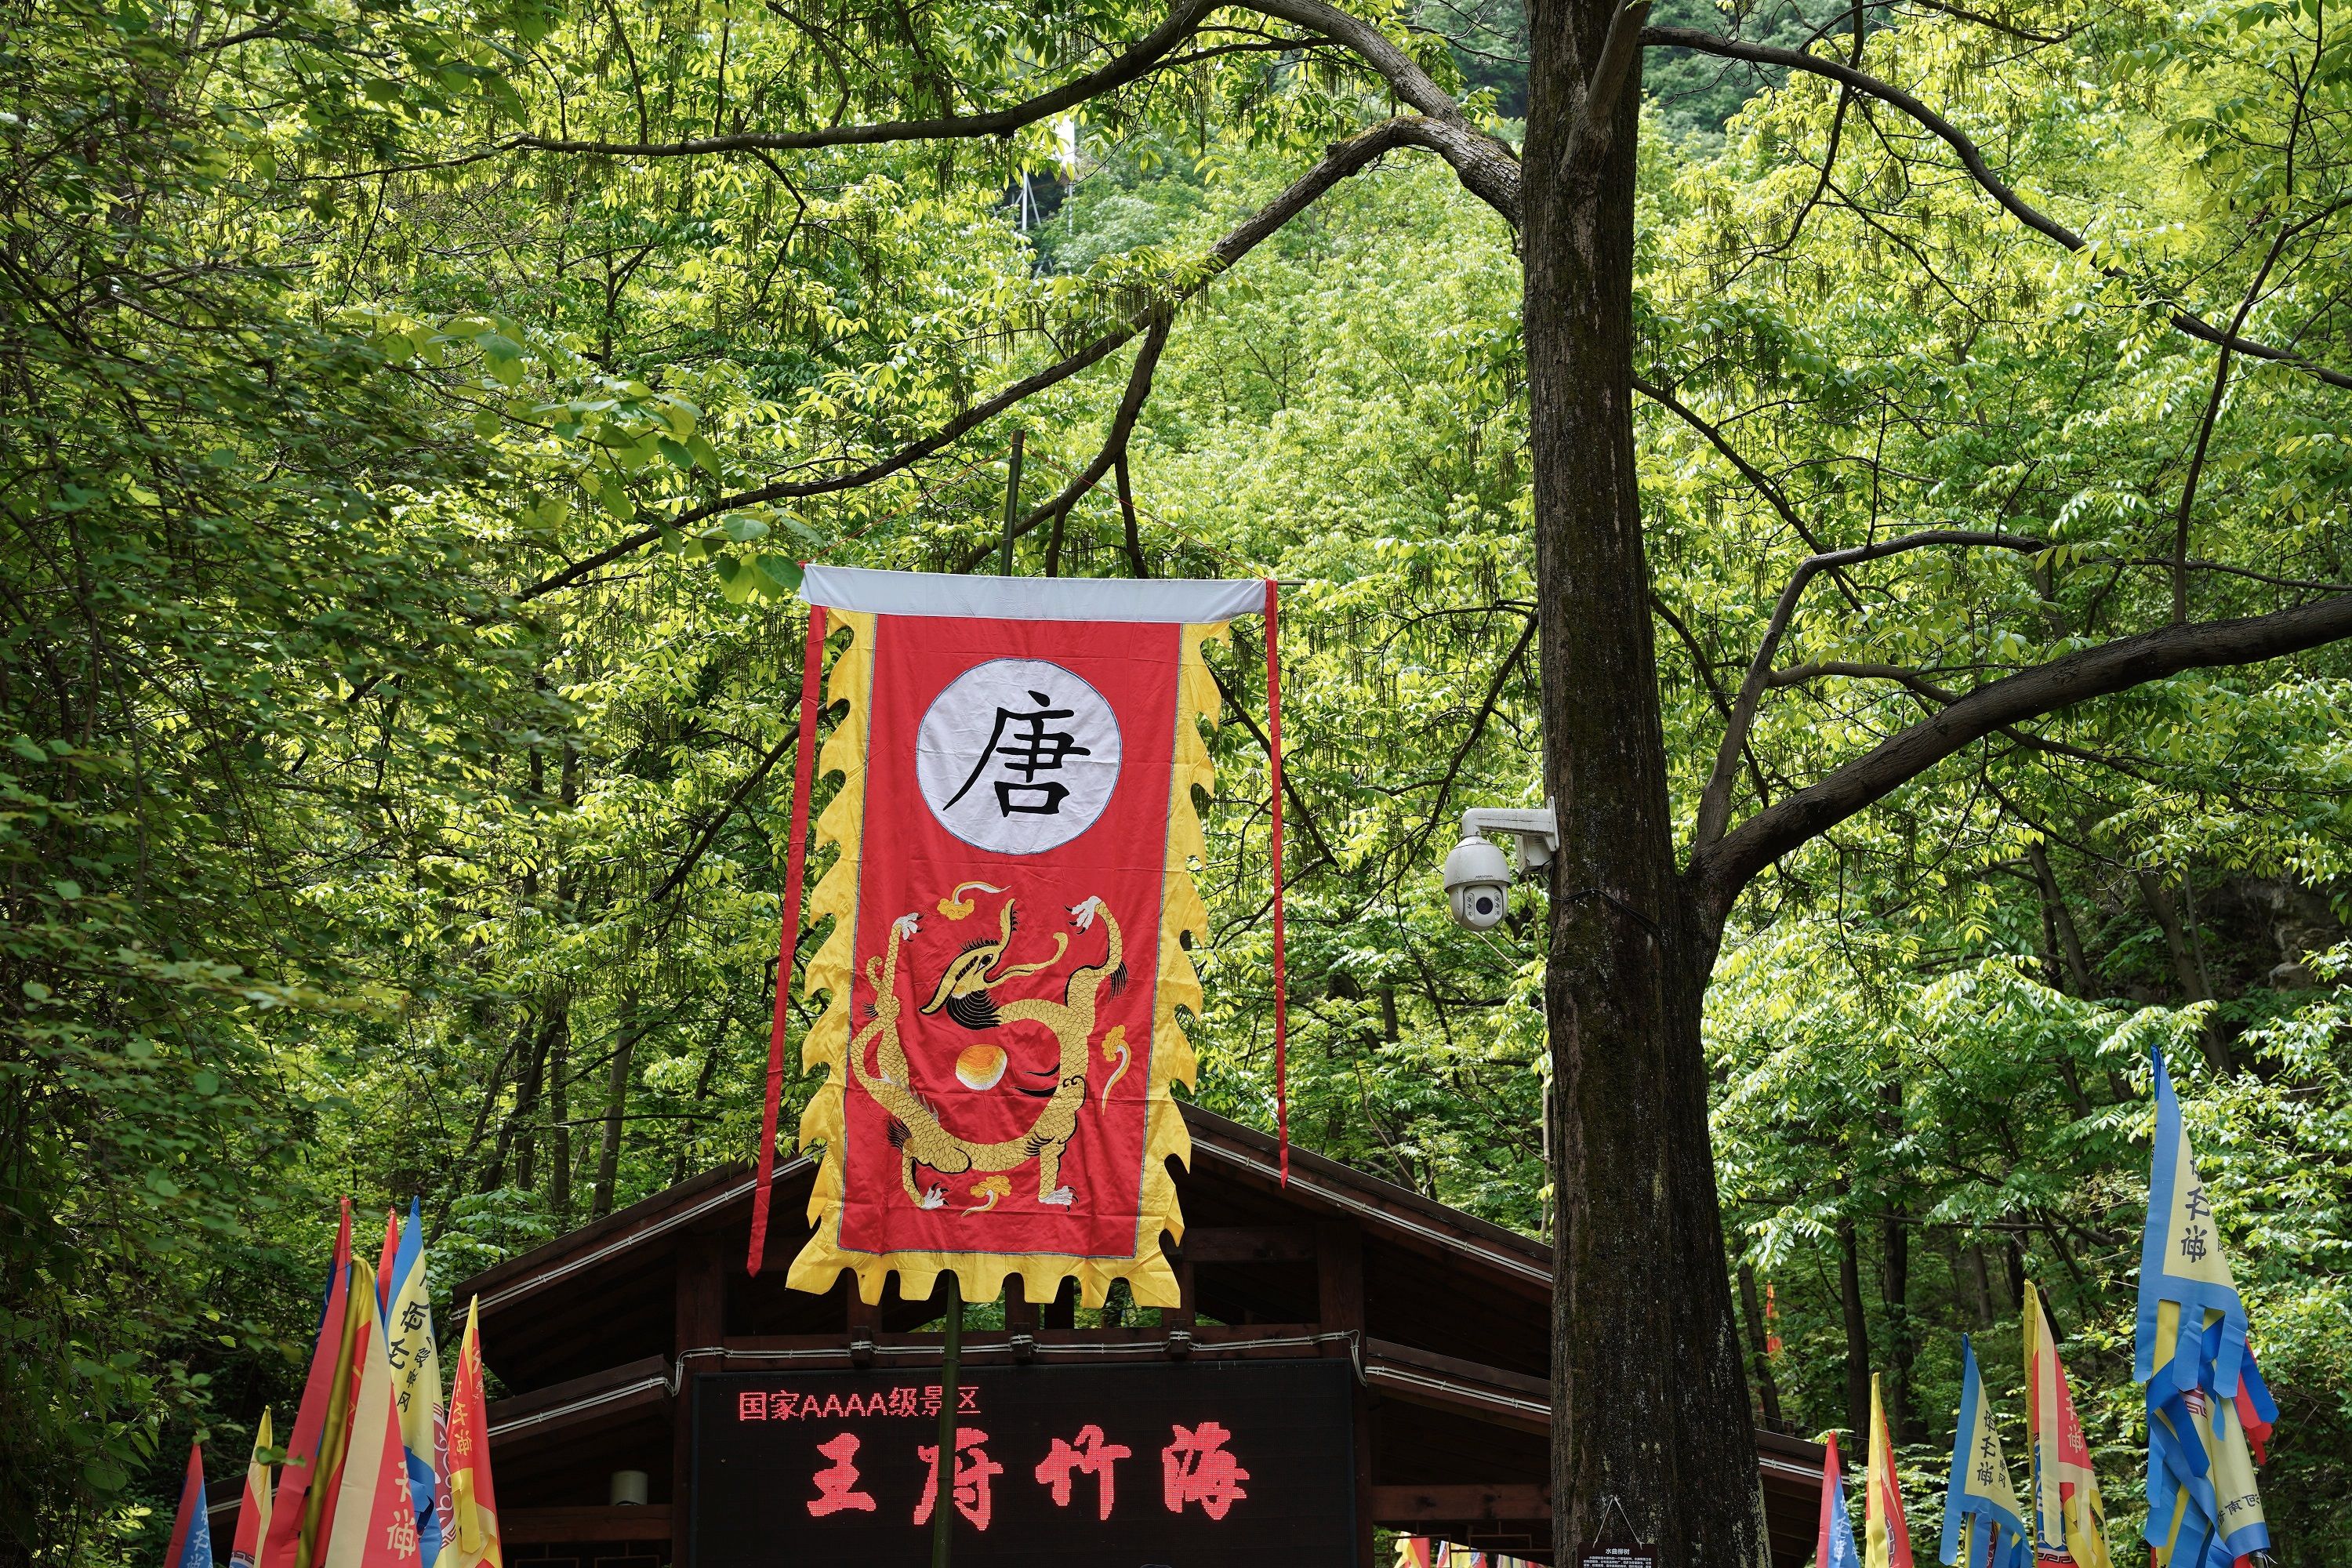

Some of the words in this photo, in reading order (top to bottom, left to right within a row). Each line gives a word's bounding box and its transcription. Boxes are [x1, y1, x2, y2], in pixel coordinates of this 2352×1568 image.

[943, 690, 1091, 818] 唐
[739, 1385, 981, 1421] 国家AAAA级景区
[807, 1421, 1250, 1530] 王府竹海
